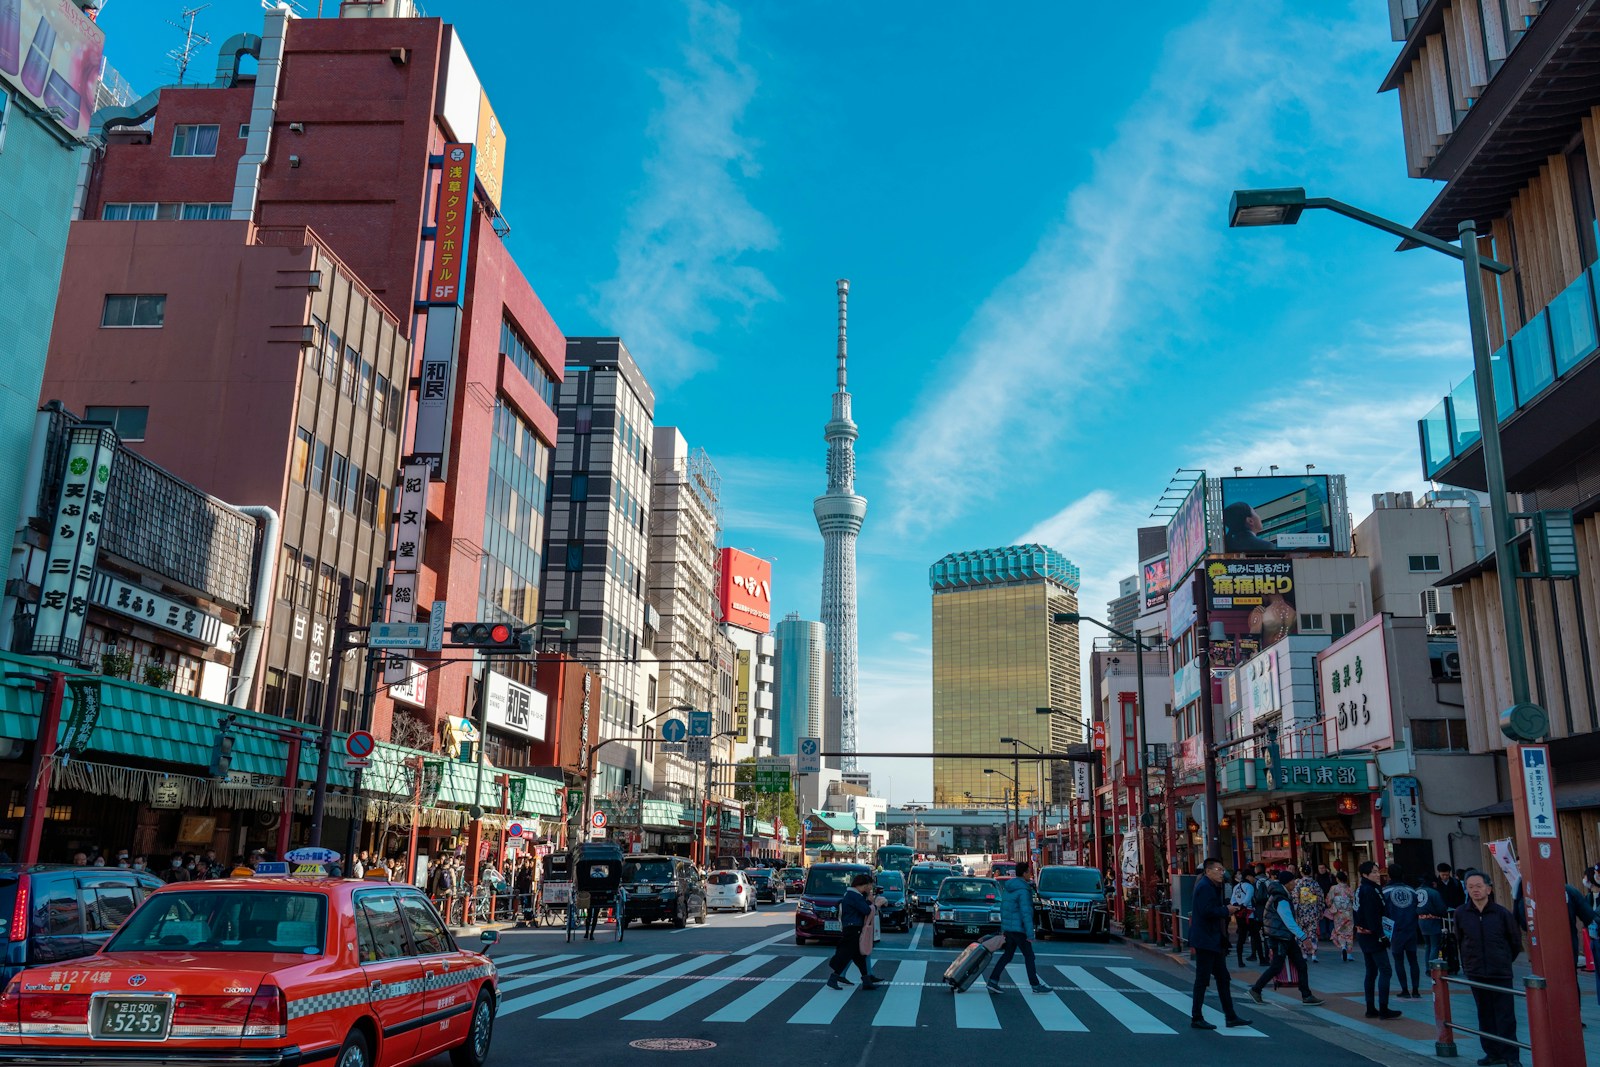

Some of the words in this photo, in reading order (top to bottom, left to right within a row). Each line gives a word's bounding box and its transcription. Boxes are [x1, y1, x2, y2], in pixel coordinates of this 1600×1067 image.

[439, 165, 463, 282] 浅草タウンホテル
[434, 285, 454, 298] 5F
[424, 363, 446, 398] 和民
[60, 483, 86, 540] 天ぷら
[85, 490, 107, 546] 天ぷら
[41, 558, 72, 611] 三定
[387, 477, 423, 670] 紀文堂総店
[1212, 574, 1293, 595] 痛痛貼り
[1227, 563, 1291, 574] 痛みに貼るだけ
[68, 564, 93, 618] 三定
[119, 587, 155, 617] 天ぷら
[167, 605, 197, 633] 三定
[431, 602, 444, 650] スクランブル式
[374, 638, 408, 646] Kaminarimon
[409, 638, 422, 646] Gate
[380, 626, 419, 637] 雷門
[507, 688, 530, 729] 和民
[1338, 693, 1370, 731] 西むら
[1534, 769, 1545, 813] 東京スカイツリー
[300, 863, 317, 873] 1274
[48, 971, 112, 984] 無1274線
[223, 986, 252, 994] CROWN
[106, 1018, 113, 1028] え
[114, 1014, 162, 1032] 52-53
[119, 1003, 137, 1013] 足立
[138, 1003, 154, 1013] 500
